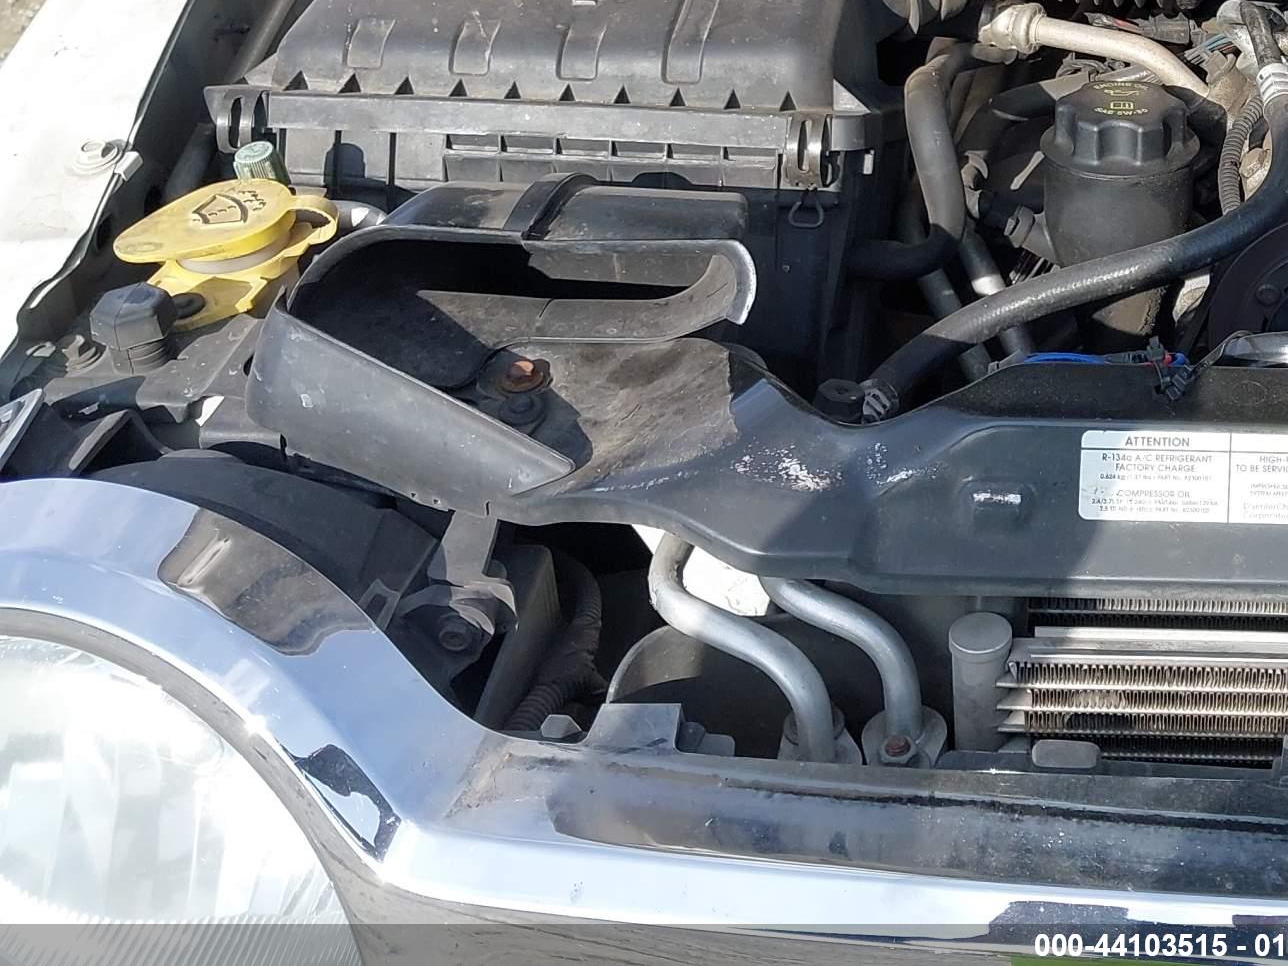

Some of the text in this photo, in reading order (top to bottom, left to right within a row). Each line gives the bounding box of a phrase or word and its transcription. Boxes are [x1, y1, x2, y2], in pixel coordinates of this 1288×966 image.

[1125, 436, 1191, 447] ATTENTION
[1155, 454, 1213, 463] REFRIGERANT
[1115, 463, 1196, 472] FACTORY CHARGE
[1236, 464, 1248, 472] TO
[1116, 489, 1175, 498] COMPRESSOR
[1177, 490, 1192, 498] OIL
